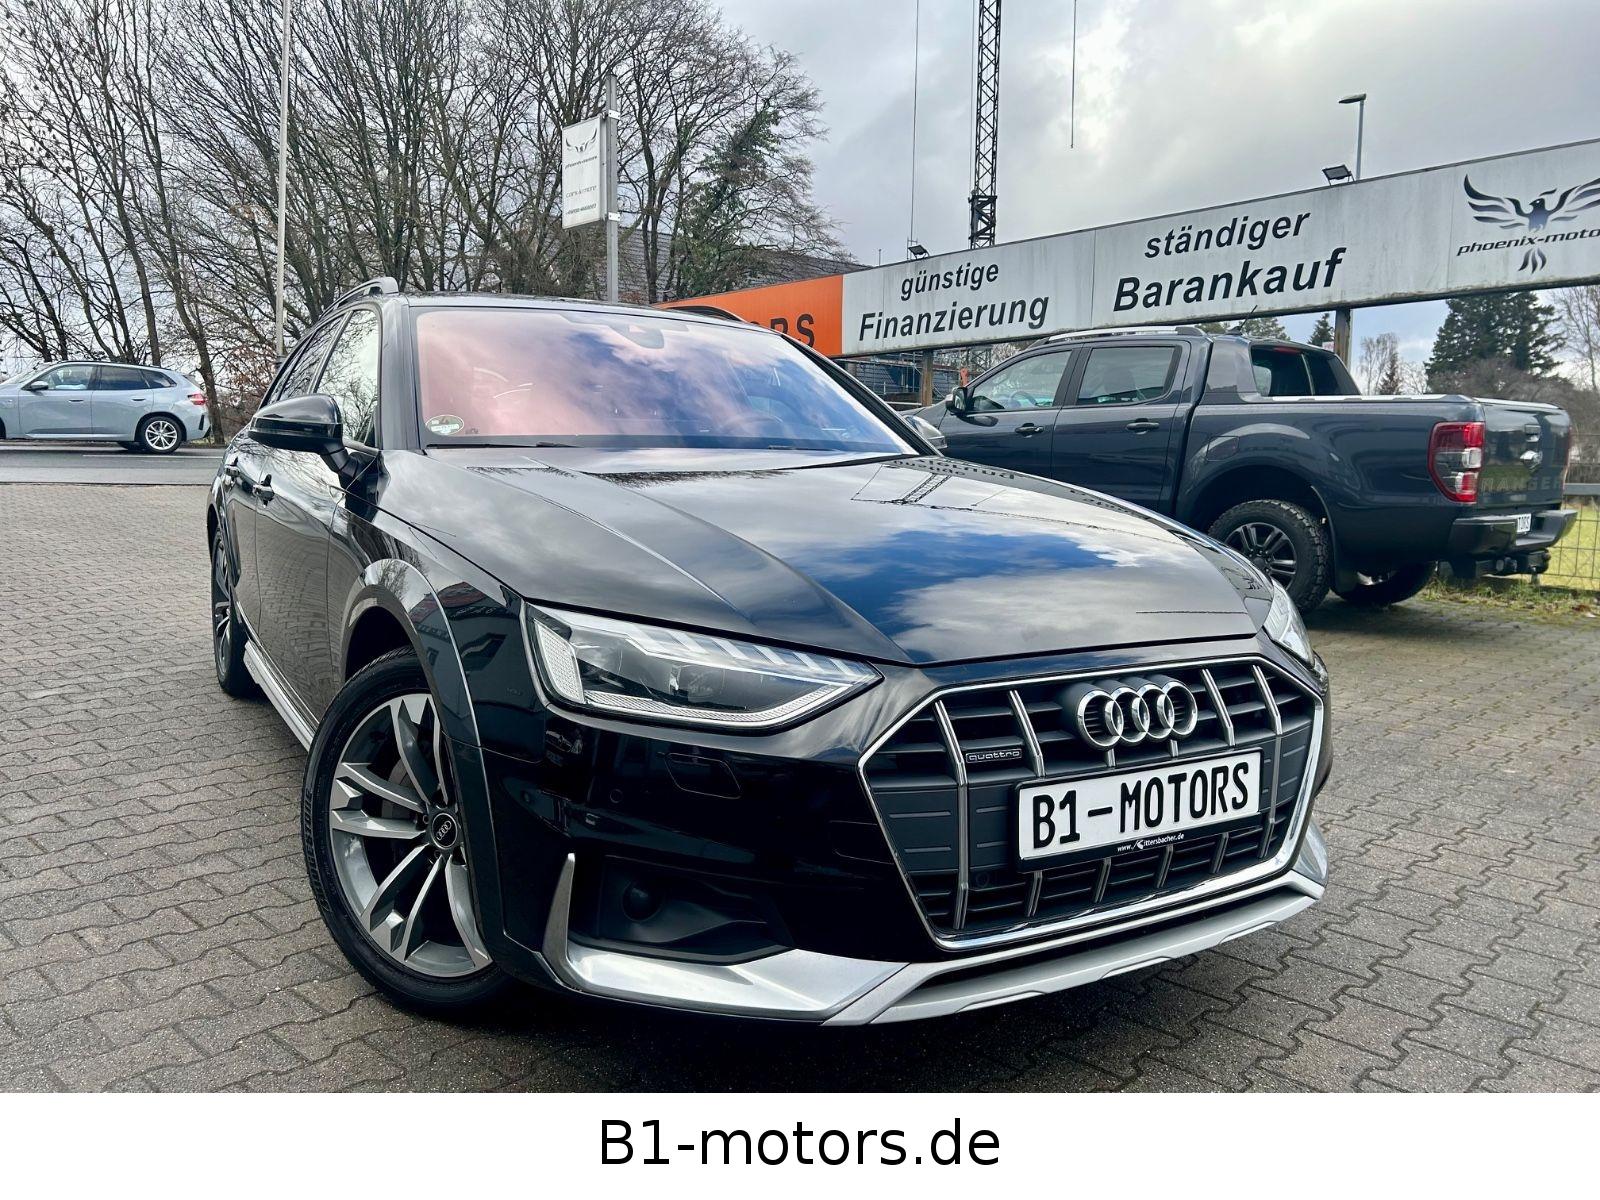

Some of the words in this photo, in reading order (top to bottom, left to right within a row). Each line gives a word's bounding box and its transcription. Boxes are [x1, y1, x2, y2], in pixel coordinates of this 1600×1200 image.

[1144, 212, 1311, 259] ständiger
[1456, 228, 1600, 256] phoenix-moto
[901, 262, 999, 300] günstige
[1113, 247, 1347, 311] Barankauf
[859, 296, 1049, 342] Finanzierung
[968, 750, 1020, 762] quattro
[1032, 762, 1249, 849] B1-MOTORS
